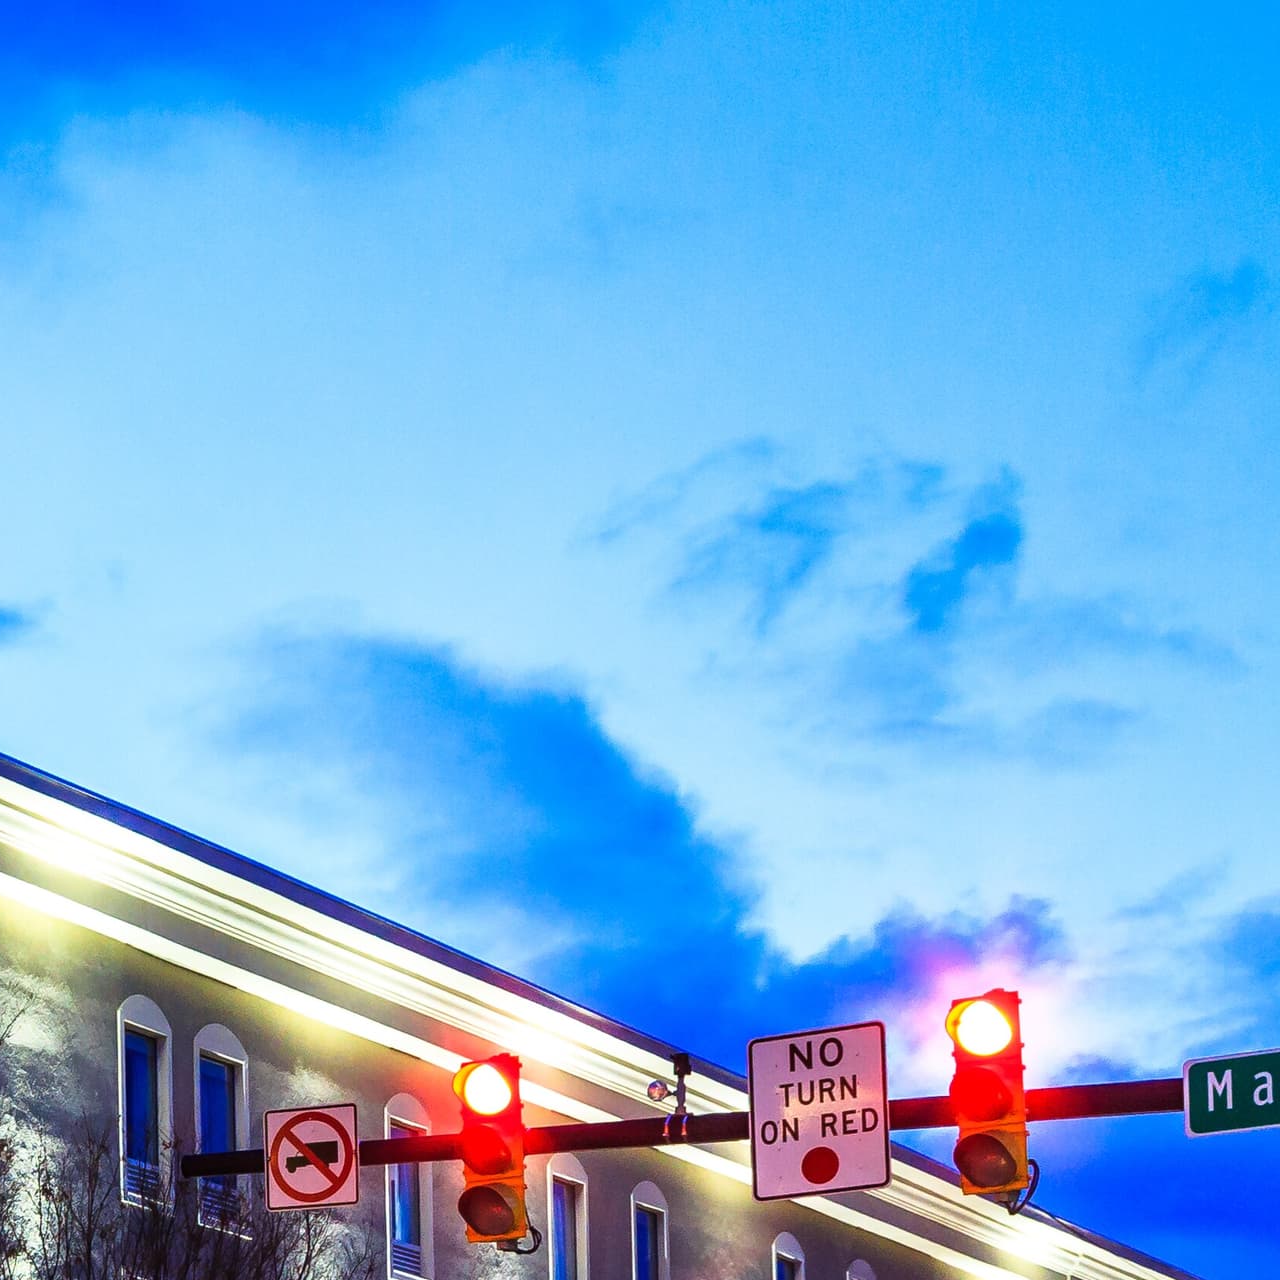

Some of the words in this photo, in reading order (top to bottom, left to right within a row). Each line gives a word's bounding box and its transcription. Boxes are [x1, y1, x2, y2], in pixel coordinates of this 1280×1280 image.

[788, 1037, 844, 1073] NO
[779, 1074, 858, 1107] TURN
[760, 1117, 799, 1145] ON
[820, 1107, 879, 1138] RED
